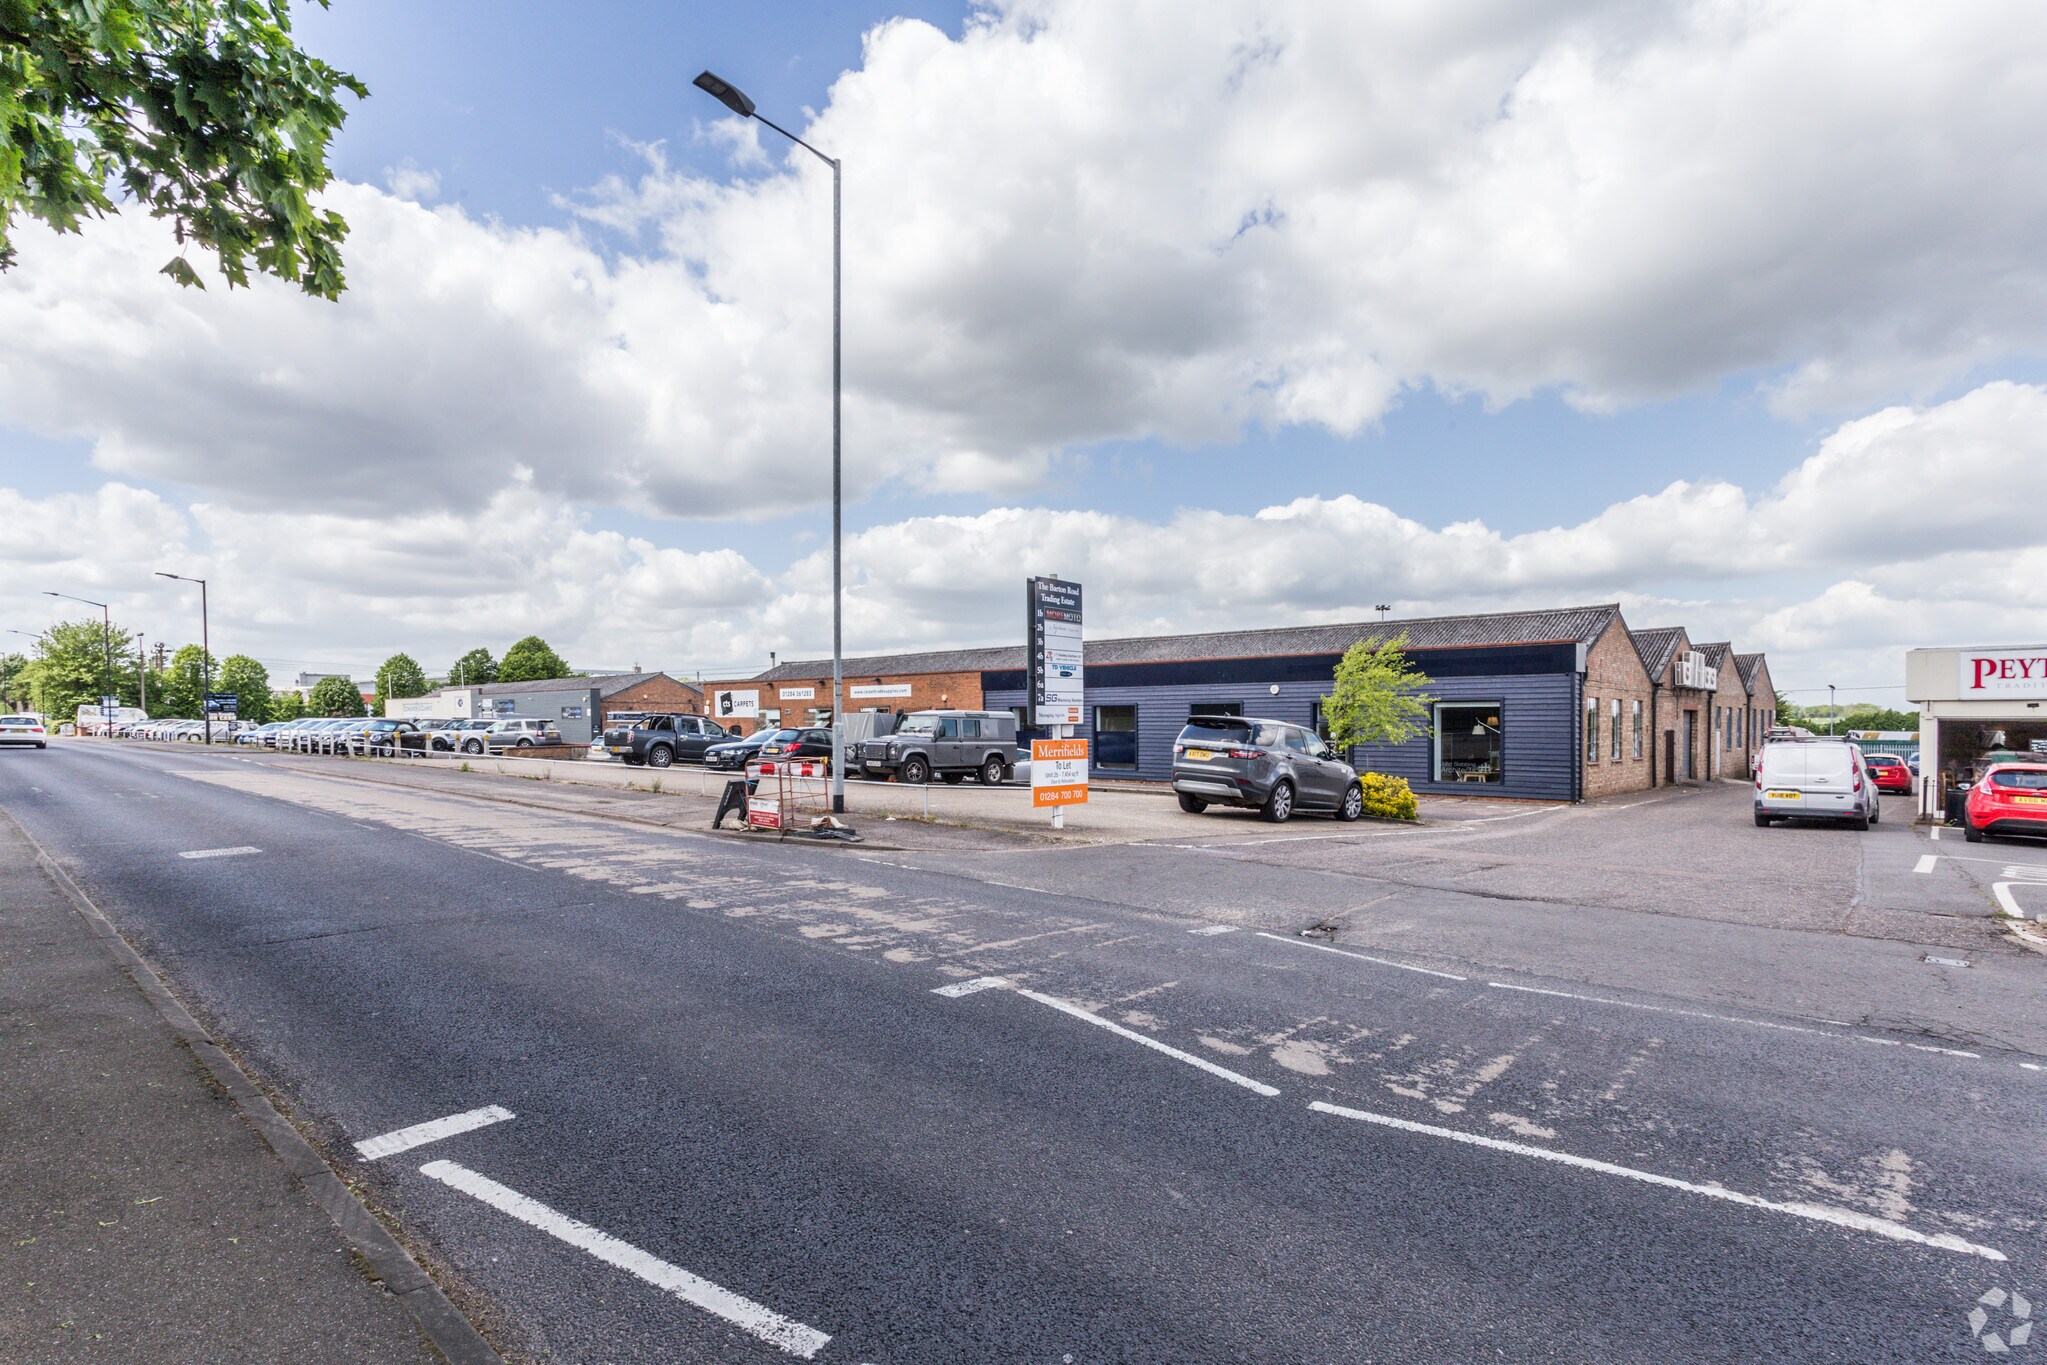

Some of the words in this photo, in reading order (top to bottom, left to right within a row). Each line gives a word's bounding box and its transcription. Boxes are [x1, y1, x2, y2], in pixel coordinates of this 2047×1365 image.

[1037, 582, 1048, 590] The
[1050, 584, 1066, 593] Barton
[1067, 587, 1079, 595] Road
[1041, 593, 1060, 605] Trading
[1061, 597, 1075, 605] Estate
[1970, 658, 2047, 689] PEYT
[1046, 694, 1057, 702] SG
[734, 700, 755, 708] CARPETS
[1038, 744, 1084, 757] Merrifields
[1056, 761, 1062, 770] To
[1063, 761, 1071, 770] Let
[1040, 792, 1059, 801] 01284
[1061, 791, 1071, 799] 700
[1073, 790, 1082, 798] 700
